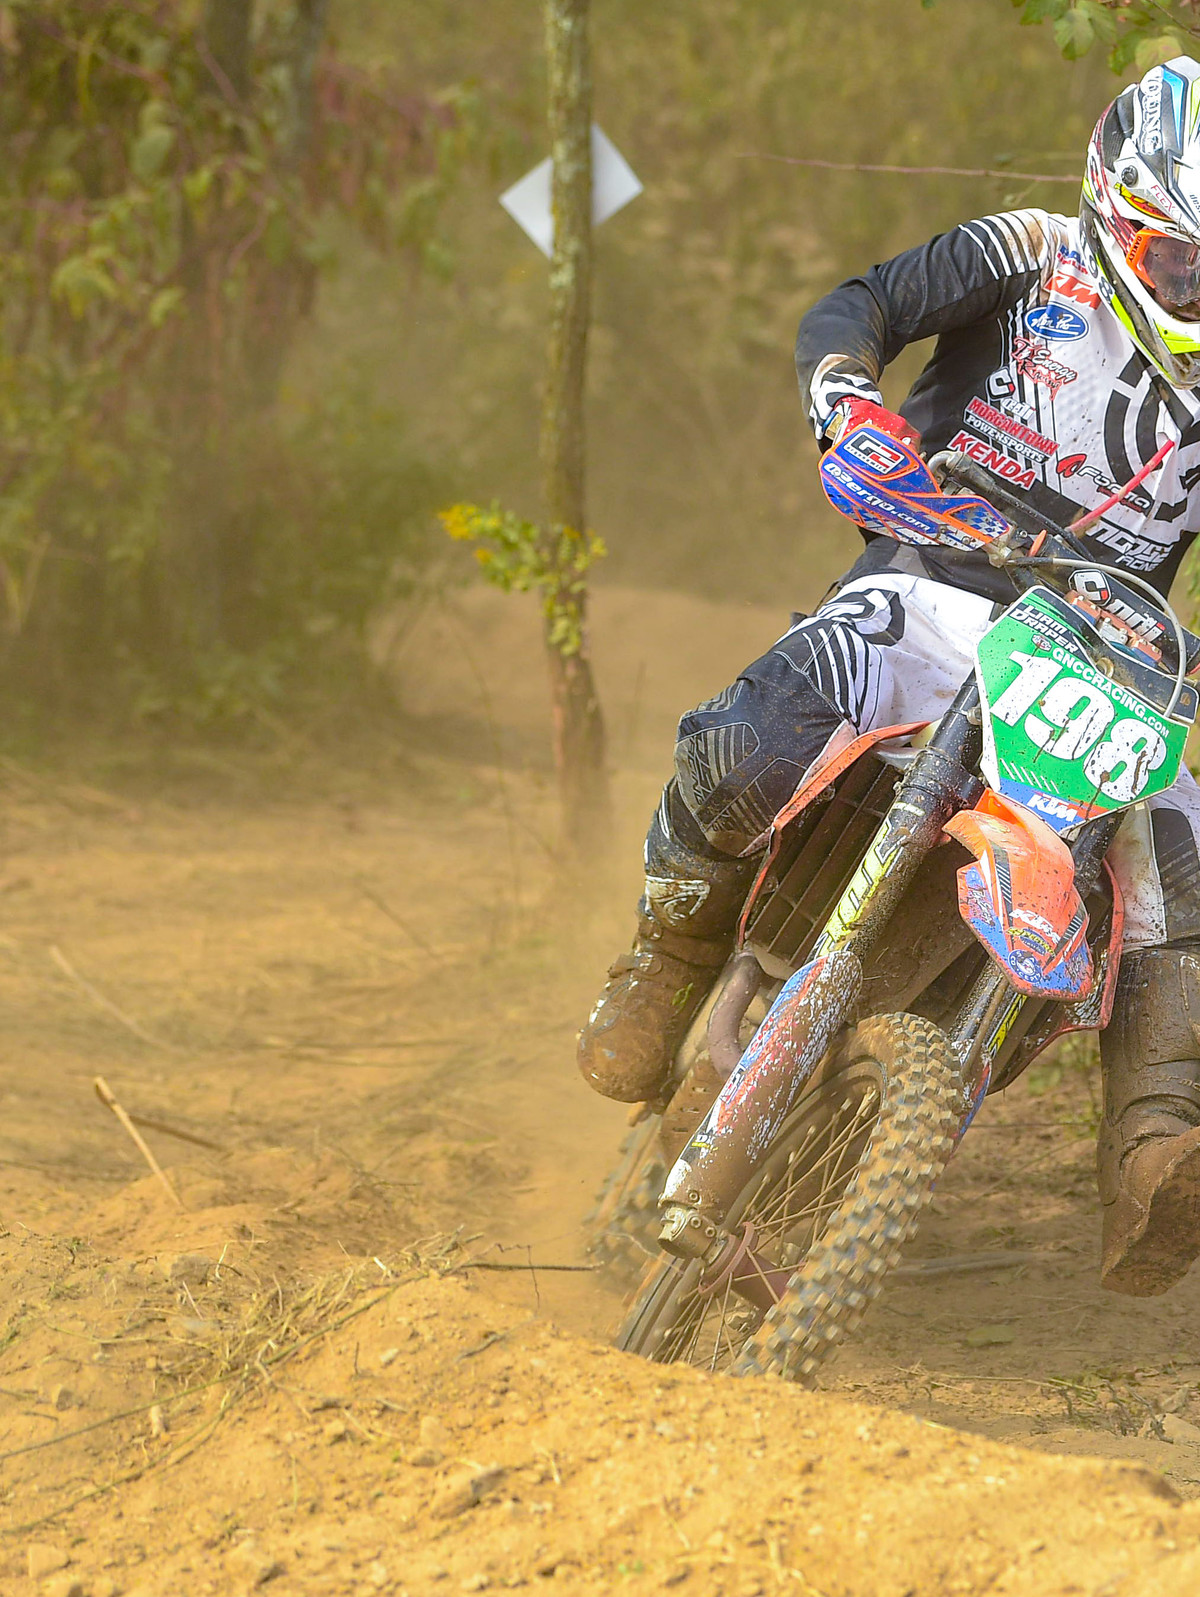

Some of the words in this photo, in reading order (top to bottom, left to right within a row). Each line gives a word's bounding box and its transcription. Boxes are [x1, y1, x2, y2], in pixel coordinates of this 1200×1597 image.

[1128, 234, 1142, 261] OAKLEY
[1044, 269, 1102, 310] KTM
[1031, 346, 1078, 383] Energy
[965, 414, 1044, 463] POWERSPORTS
[967, 397, 1060, 457] MORGANTOWN
[949, 431, 1036, 489] KENDA
[1009, 608, 1079, 653] DRAPER
[1023, 604, 1067, 635] LIAM
[1052, 647, 1170, 739] GNCCRACING.COM
[989, 650, 1167, 802] 198
[1026, 793, 1078, 823] KTM
